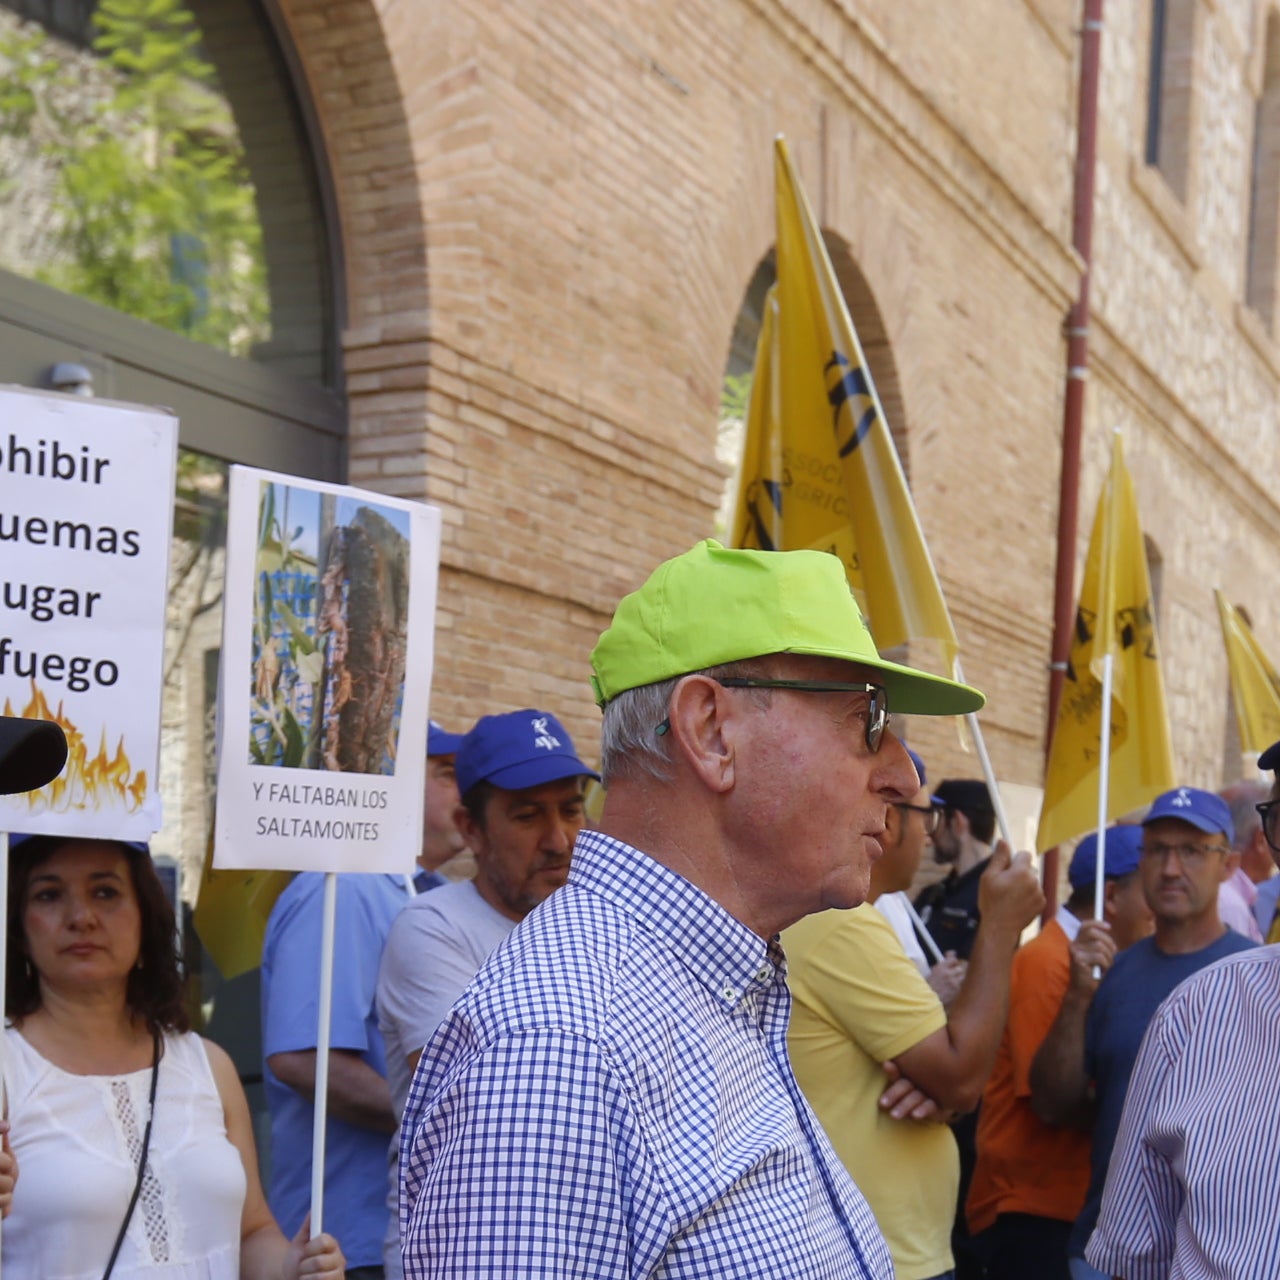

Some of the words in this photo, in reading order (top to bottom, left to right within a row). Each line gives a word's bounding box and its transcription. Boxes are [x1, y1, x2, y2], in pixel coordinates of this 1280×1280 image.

[253, 783, 264, 801] Y
[269, 783, 358, 808] FALTABAN
[361, 788, 389, 811] LOS
[256, 816, 380, 842] SALTAMONTES
